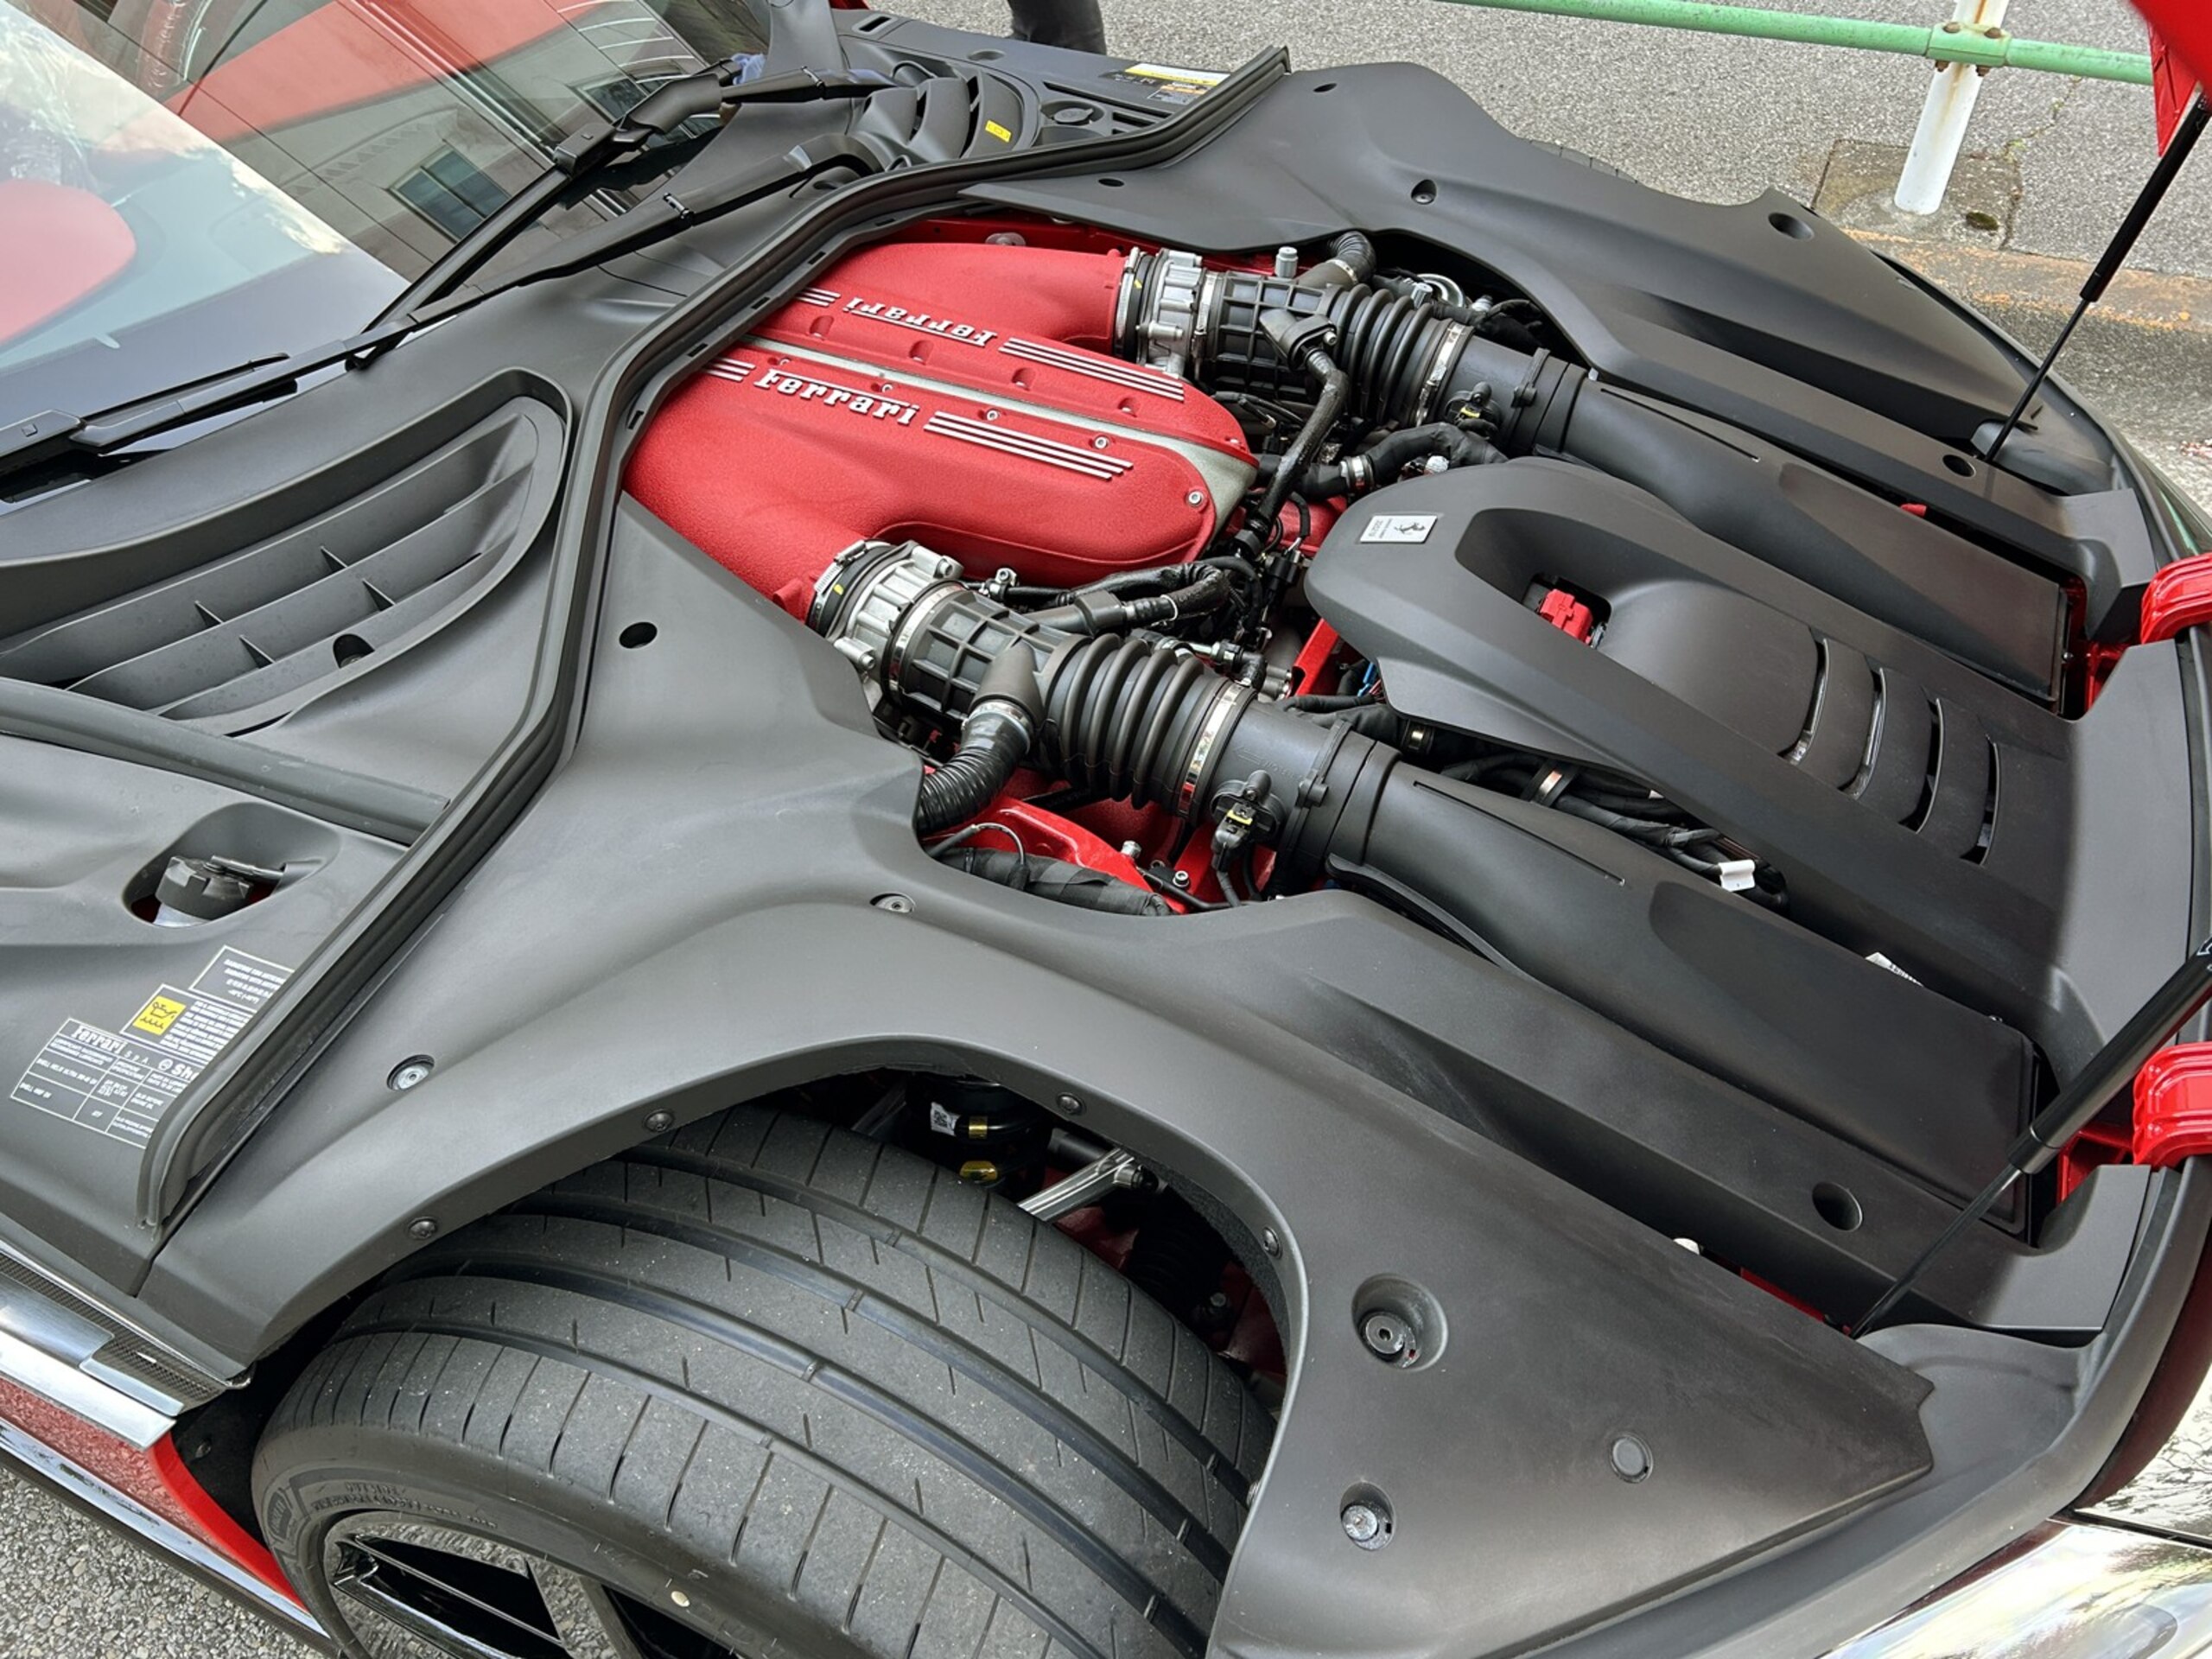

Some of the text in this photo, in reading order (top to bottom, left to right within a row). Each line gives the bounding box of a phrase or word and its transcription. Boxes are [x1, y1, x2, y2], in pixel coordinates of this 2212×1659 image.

[842, 296, 998, 347] Ferrari
[753, 368, 920, 425] Ferrari
[71, 1024, 128, 1055] Ferrari
